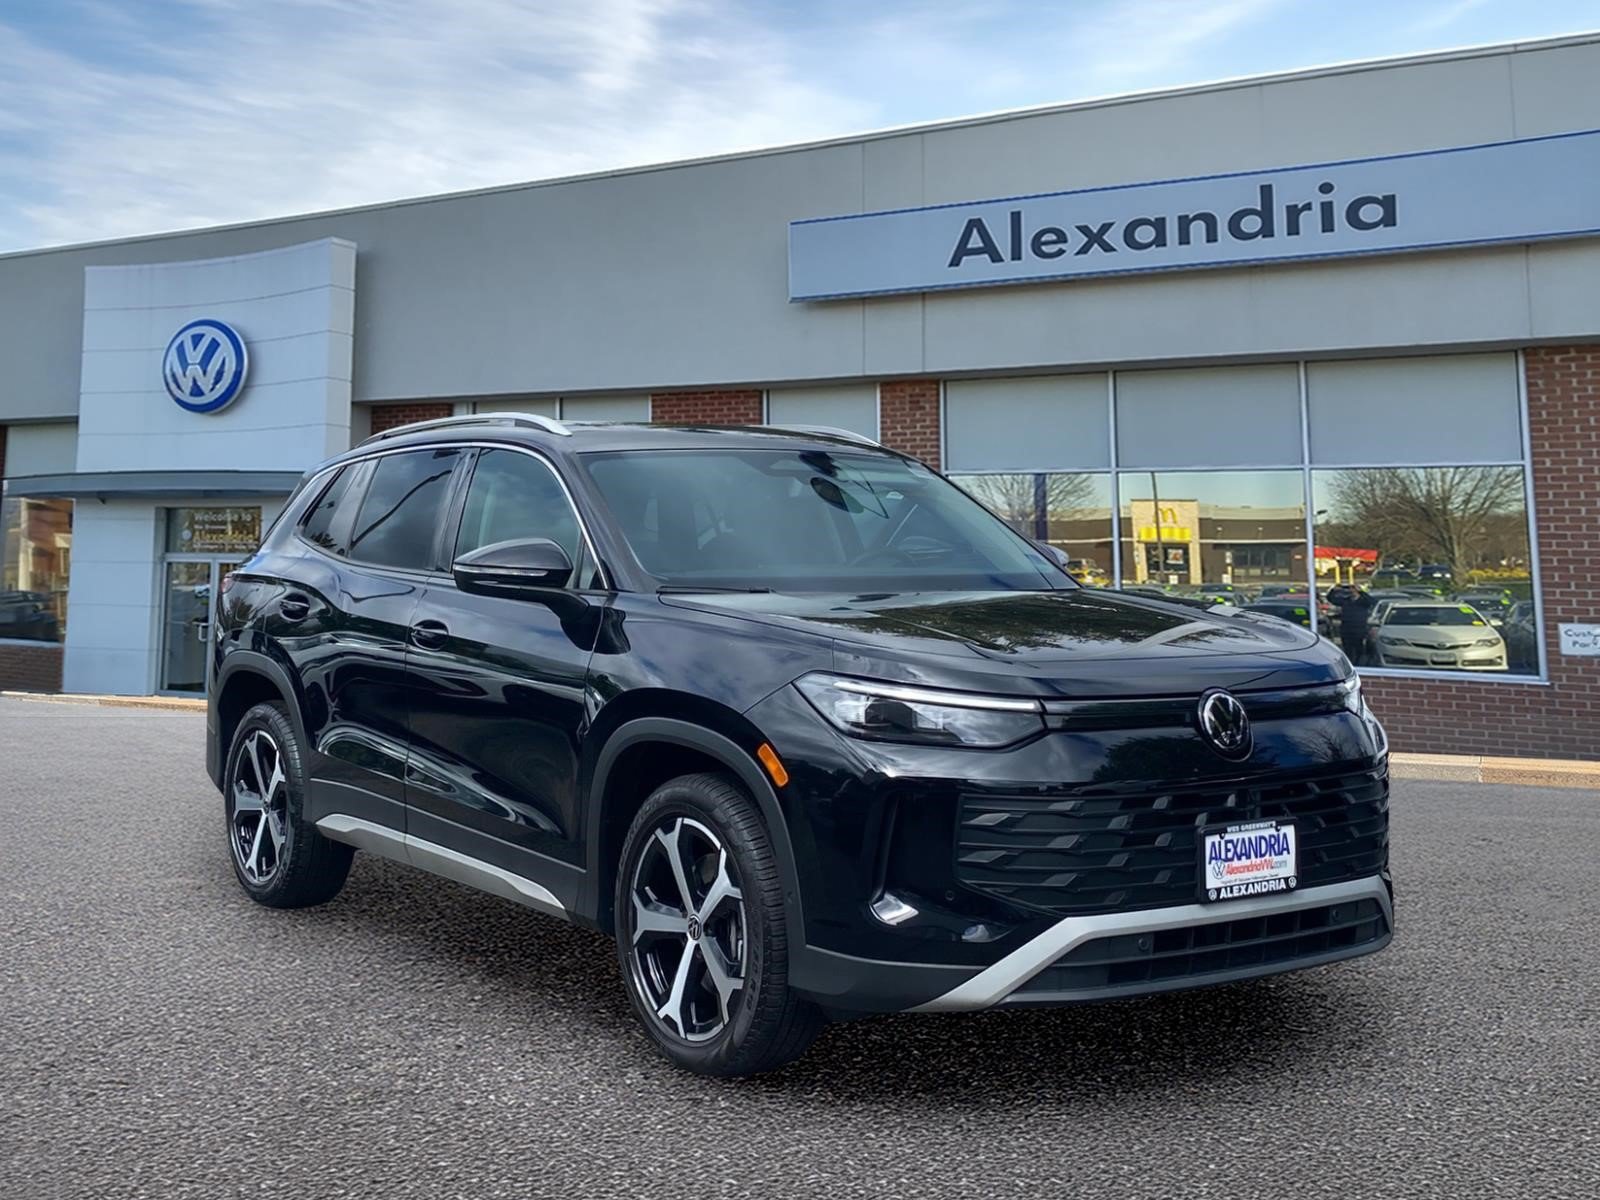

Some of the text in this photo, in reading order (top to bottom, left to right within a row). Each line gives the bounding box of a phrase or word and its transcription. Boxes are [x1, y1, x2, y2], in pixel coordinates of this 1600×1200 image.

[948, 181, 1398, 269] Alexandria
[1208, 832, 1290, 865] ALEXANDRIA
[1220, 879, 1286, 899] ALEXANDRIA
